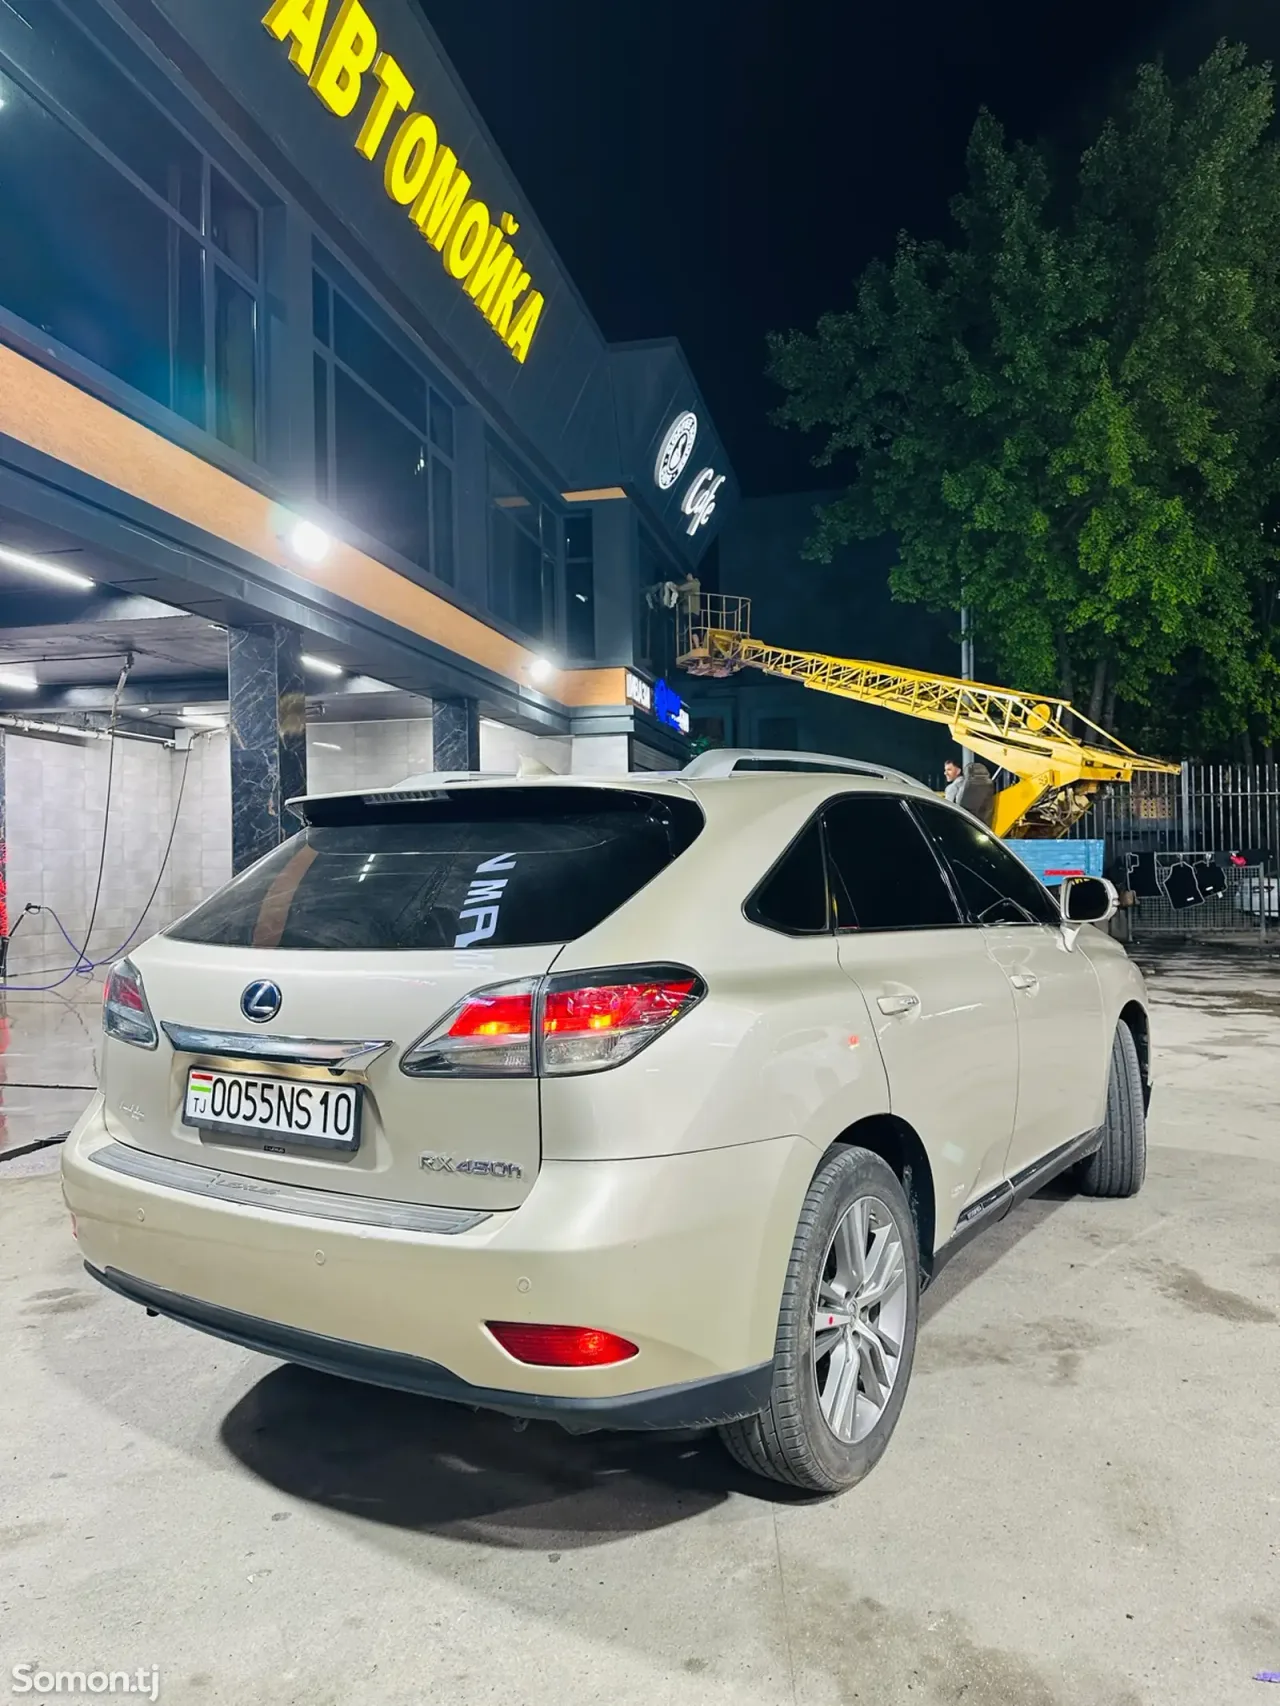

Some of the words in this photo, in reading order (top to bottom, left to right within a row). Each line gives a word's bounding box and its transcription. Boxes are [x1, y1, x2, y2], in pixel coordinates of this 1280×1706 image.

[261, 0, 545, 364] АВТОМОЙКА
[193, 1097, 207, 1114] TJ
[419, 1156, 455, 1173] RX
